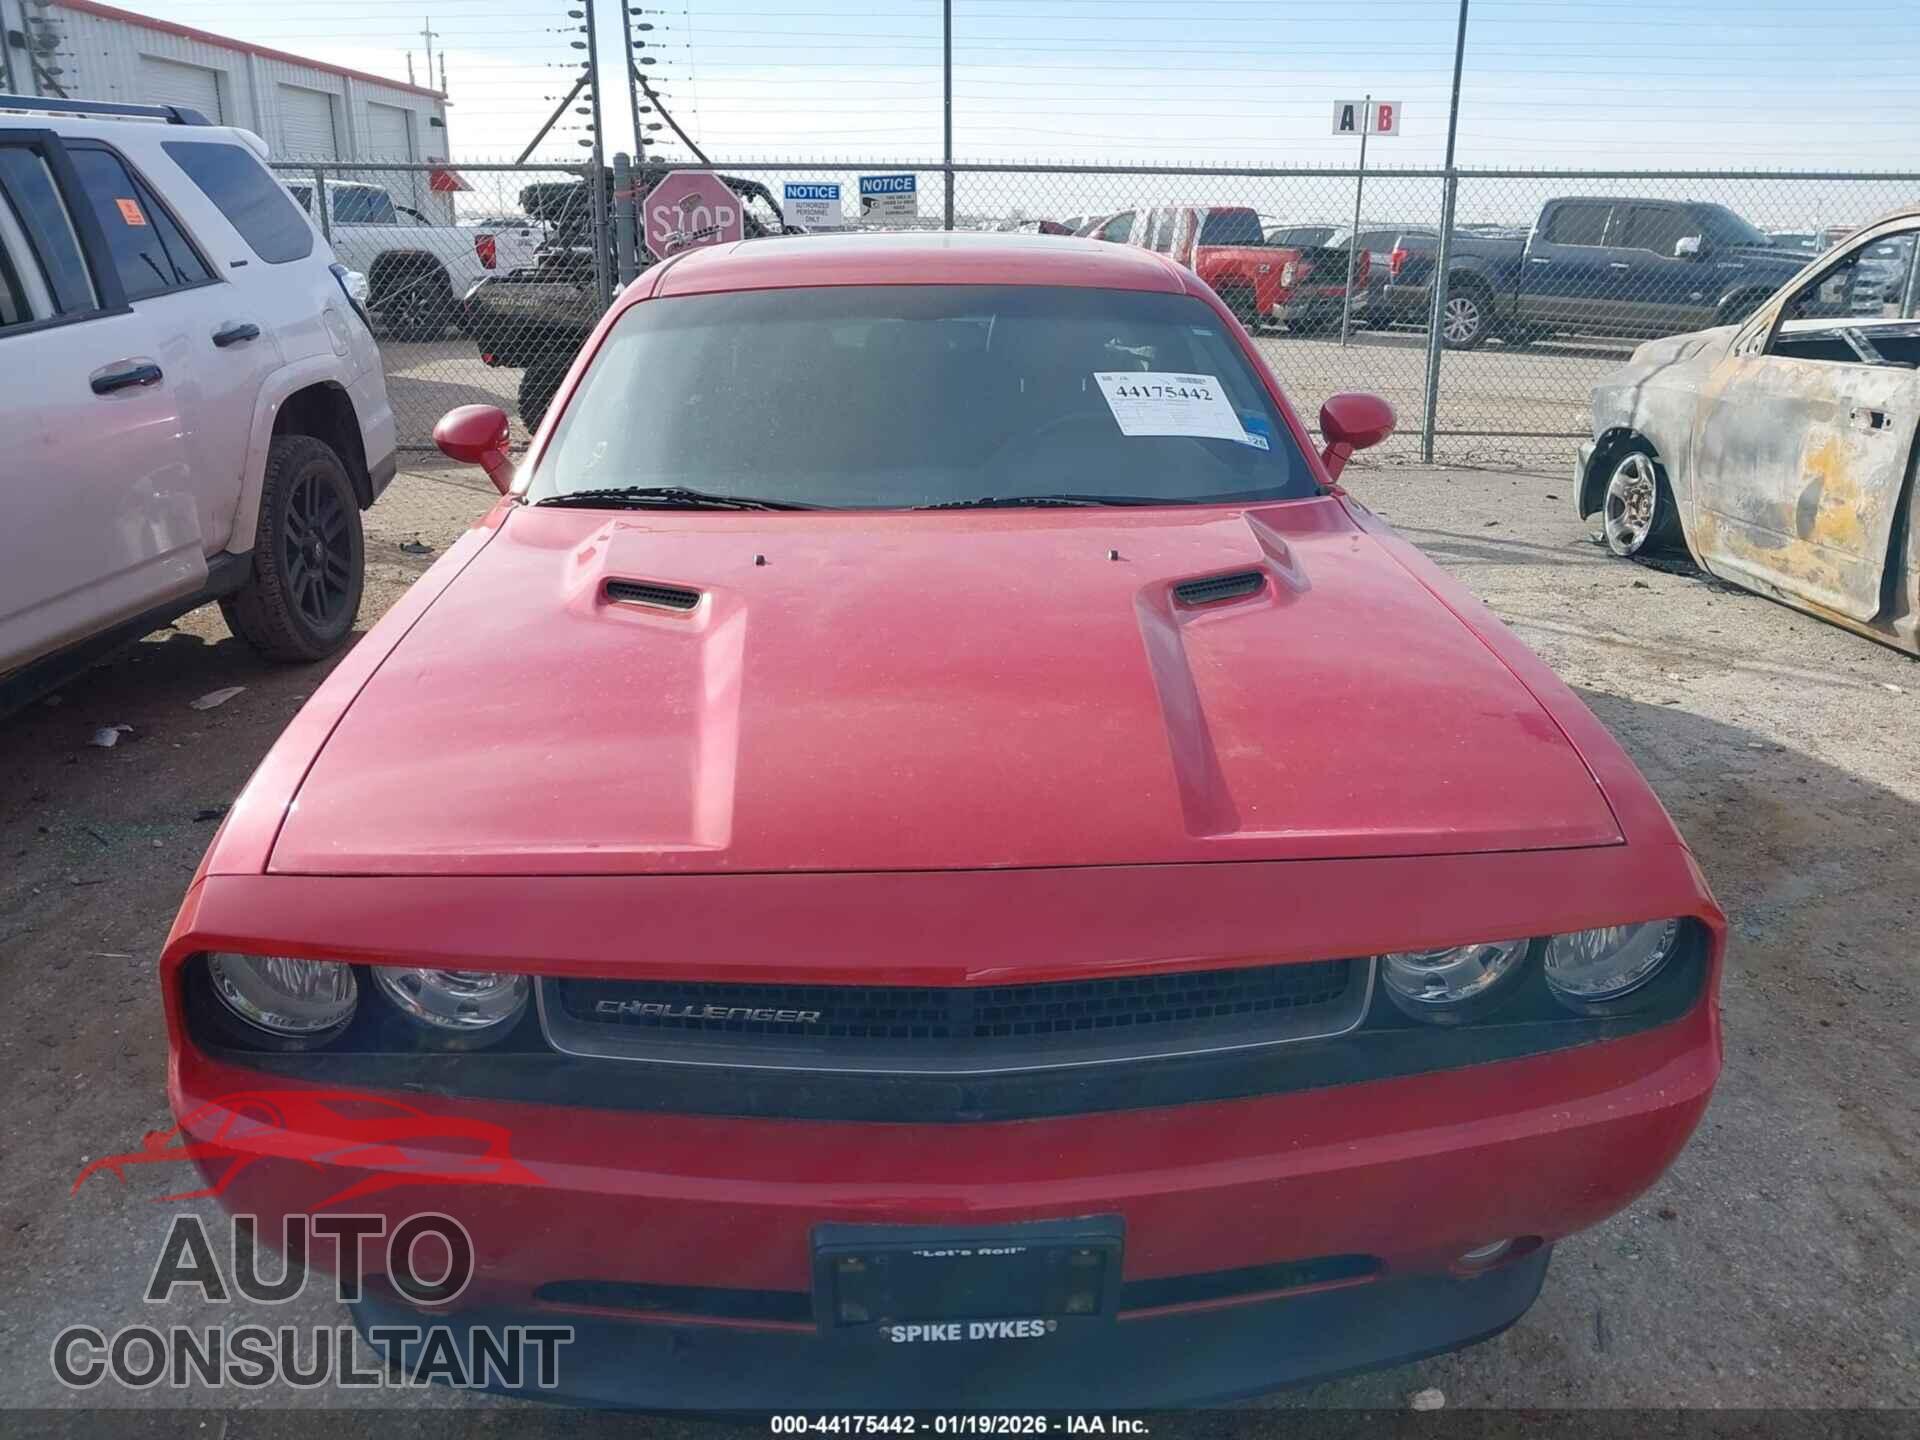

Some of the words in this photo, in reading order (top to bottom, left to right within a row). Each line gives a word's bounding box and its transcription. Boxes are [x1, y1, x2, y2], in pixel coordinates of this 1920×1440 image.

[1340, 105, 1354, 131] A
[1377, 105, 1393, 131] B
[787, 186, 837, 198] NOTICE
[862, 178, 913, 192] NOTICE
[652, 205, 735, 242] STOP
[1116, 385, 1213, 401] 44175442
[595, 999, 822, 1024] CHALLENGER
[891, 1324, 961, 1343] SPIKE
[969, 1319, 1045, 1340] DYKES
